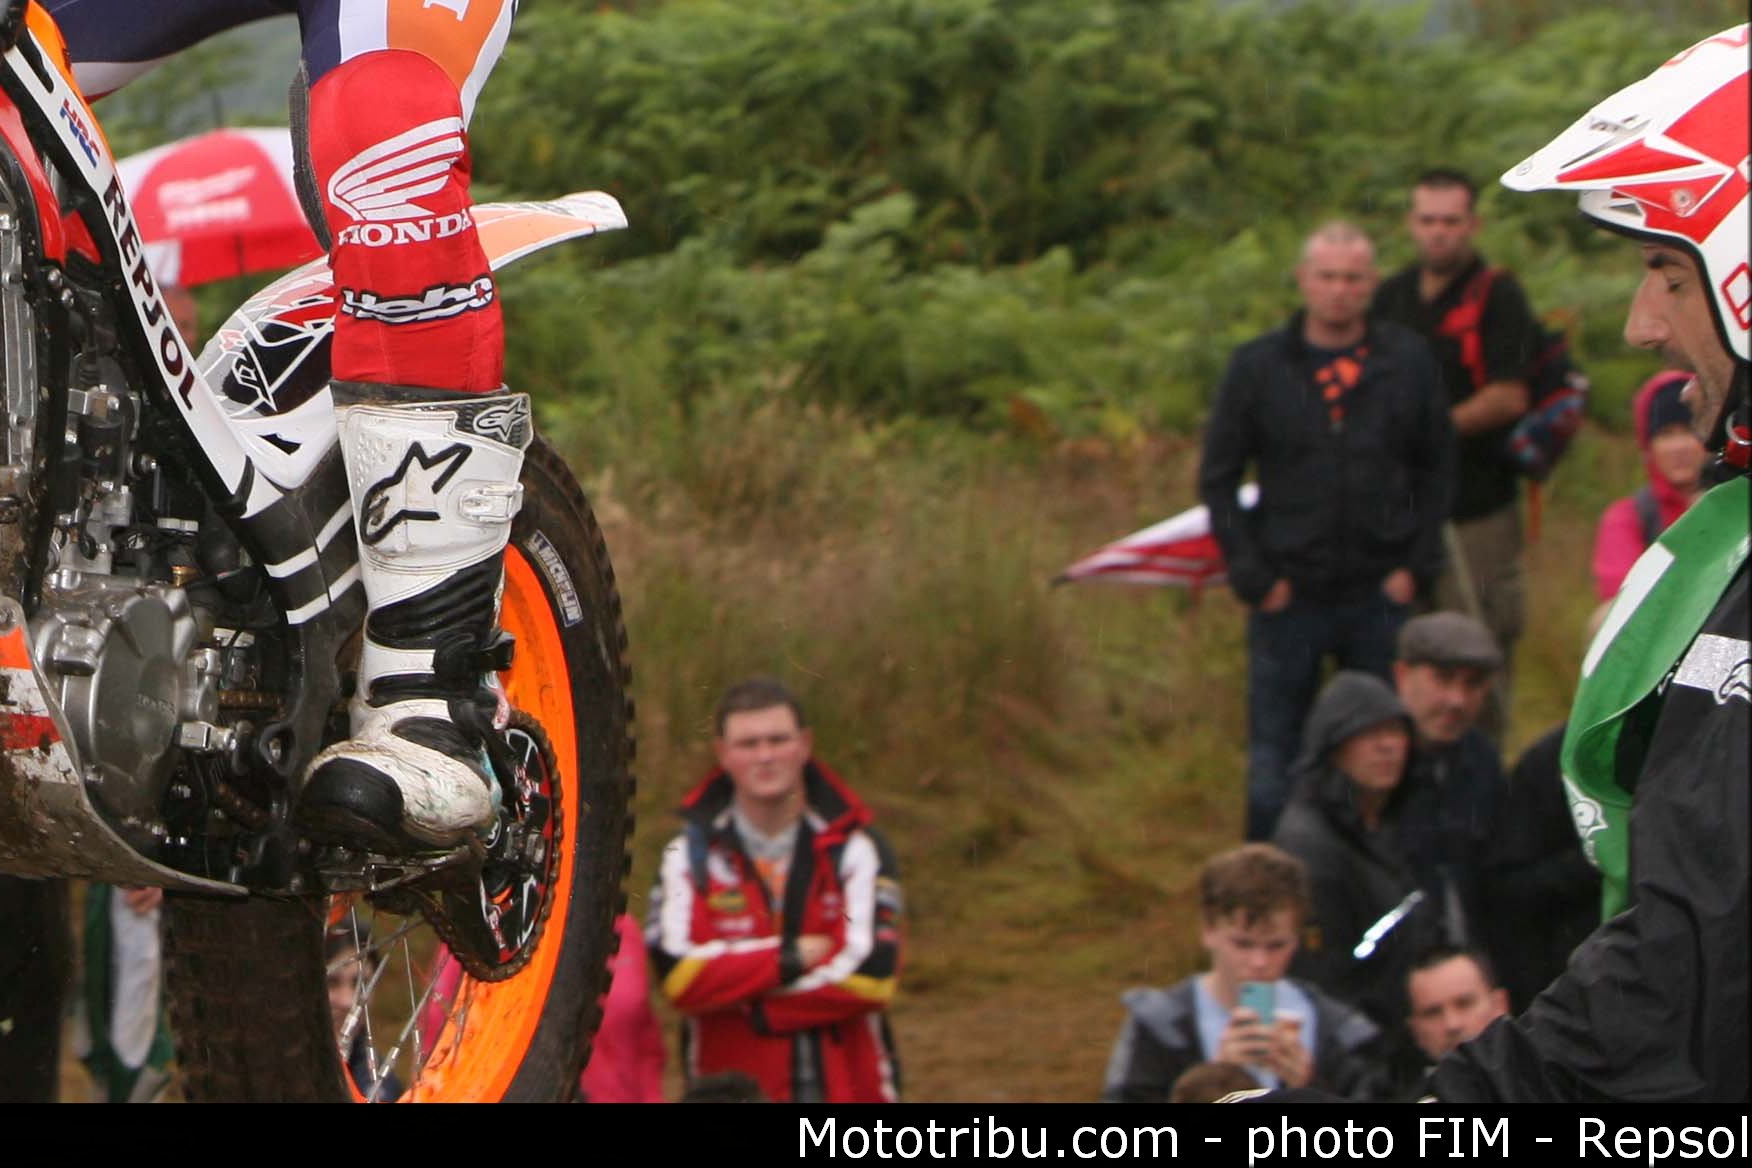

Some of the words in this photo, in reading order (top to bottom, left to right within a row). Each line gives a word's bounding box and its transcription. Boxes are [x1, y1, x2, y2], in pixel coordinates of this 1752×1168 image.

[58, 98, 101, 169] HRC
[338, 208, 473, 247] HONDA
[102, 174, 195, 411] REPSOL
